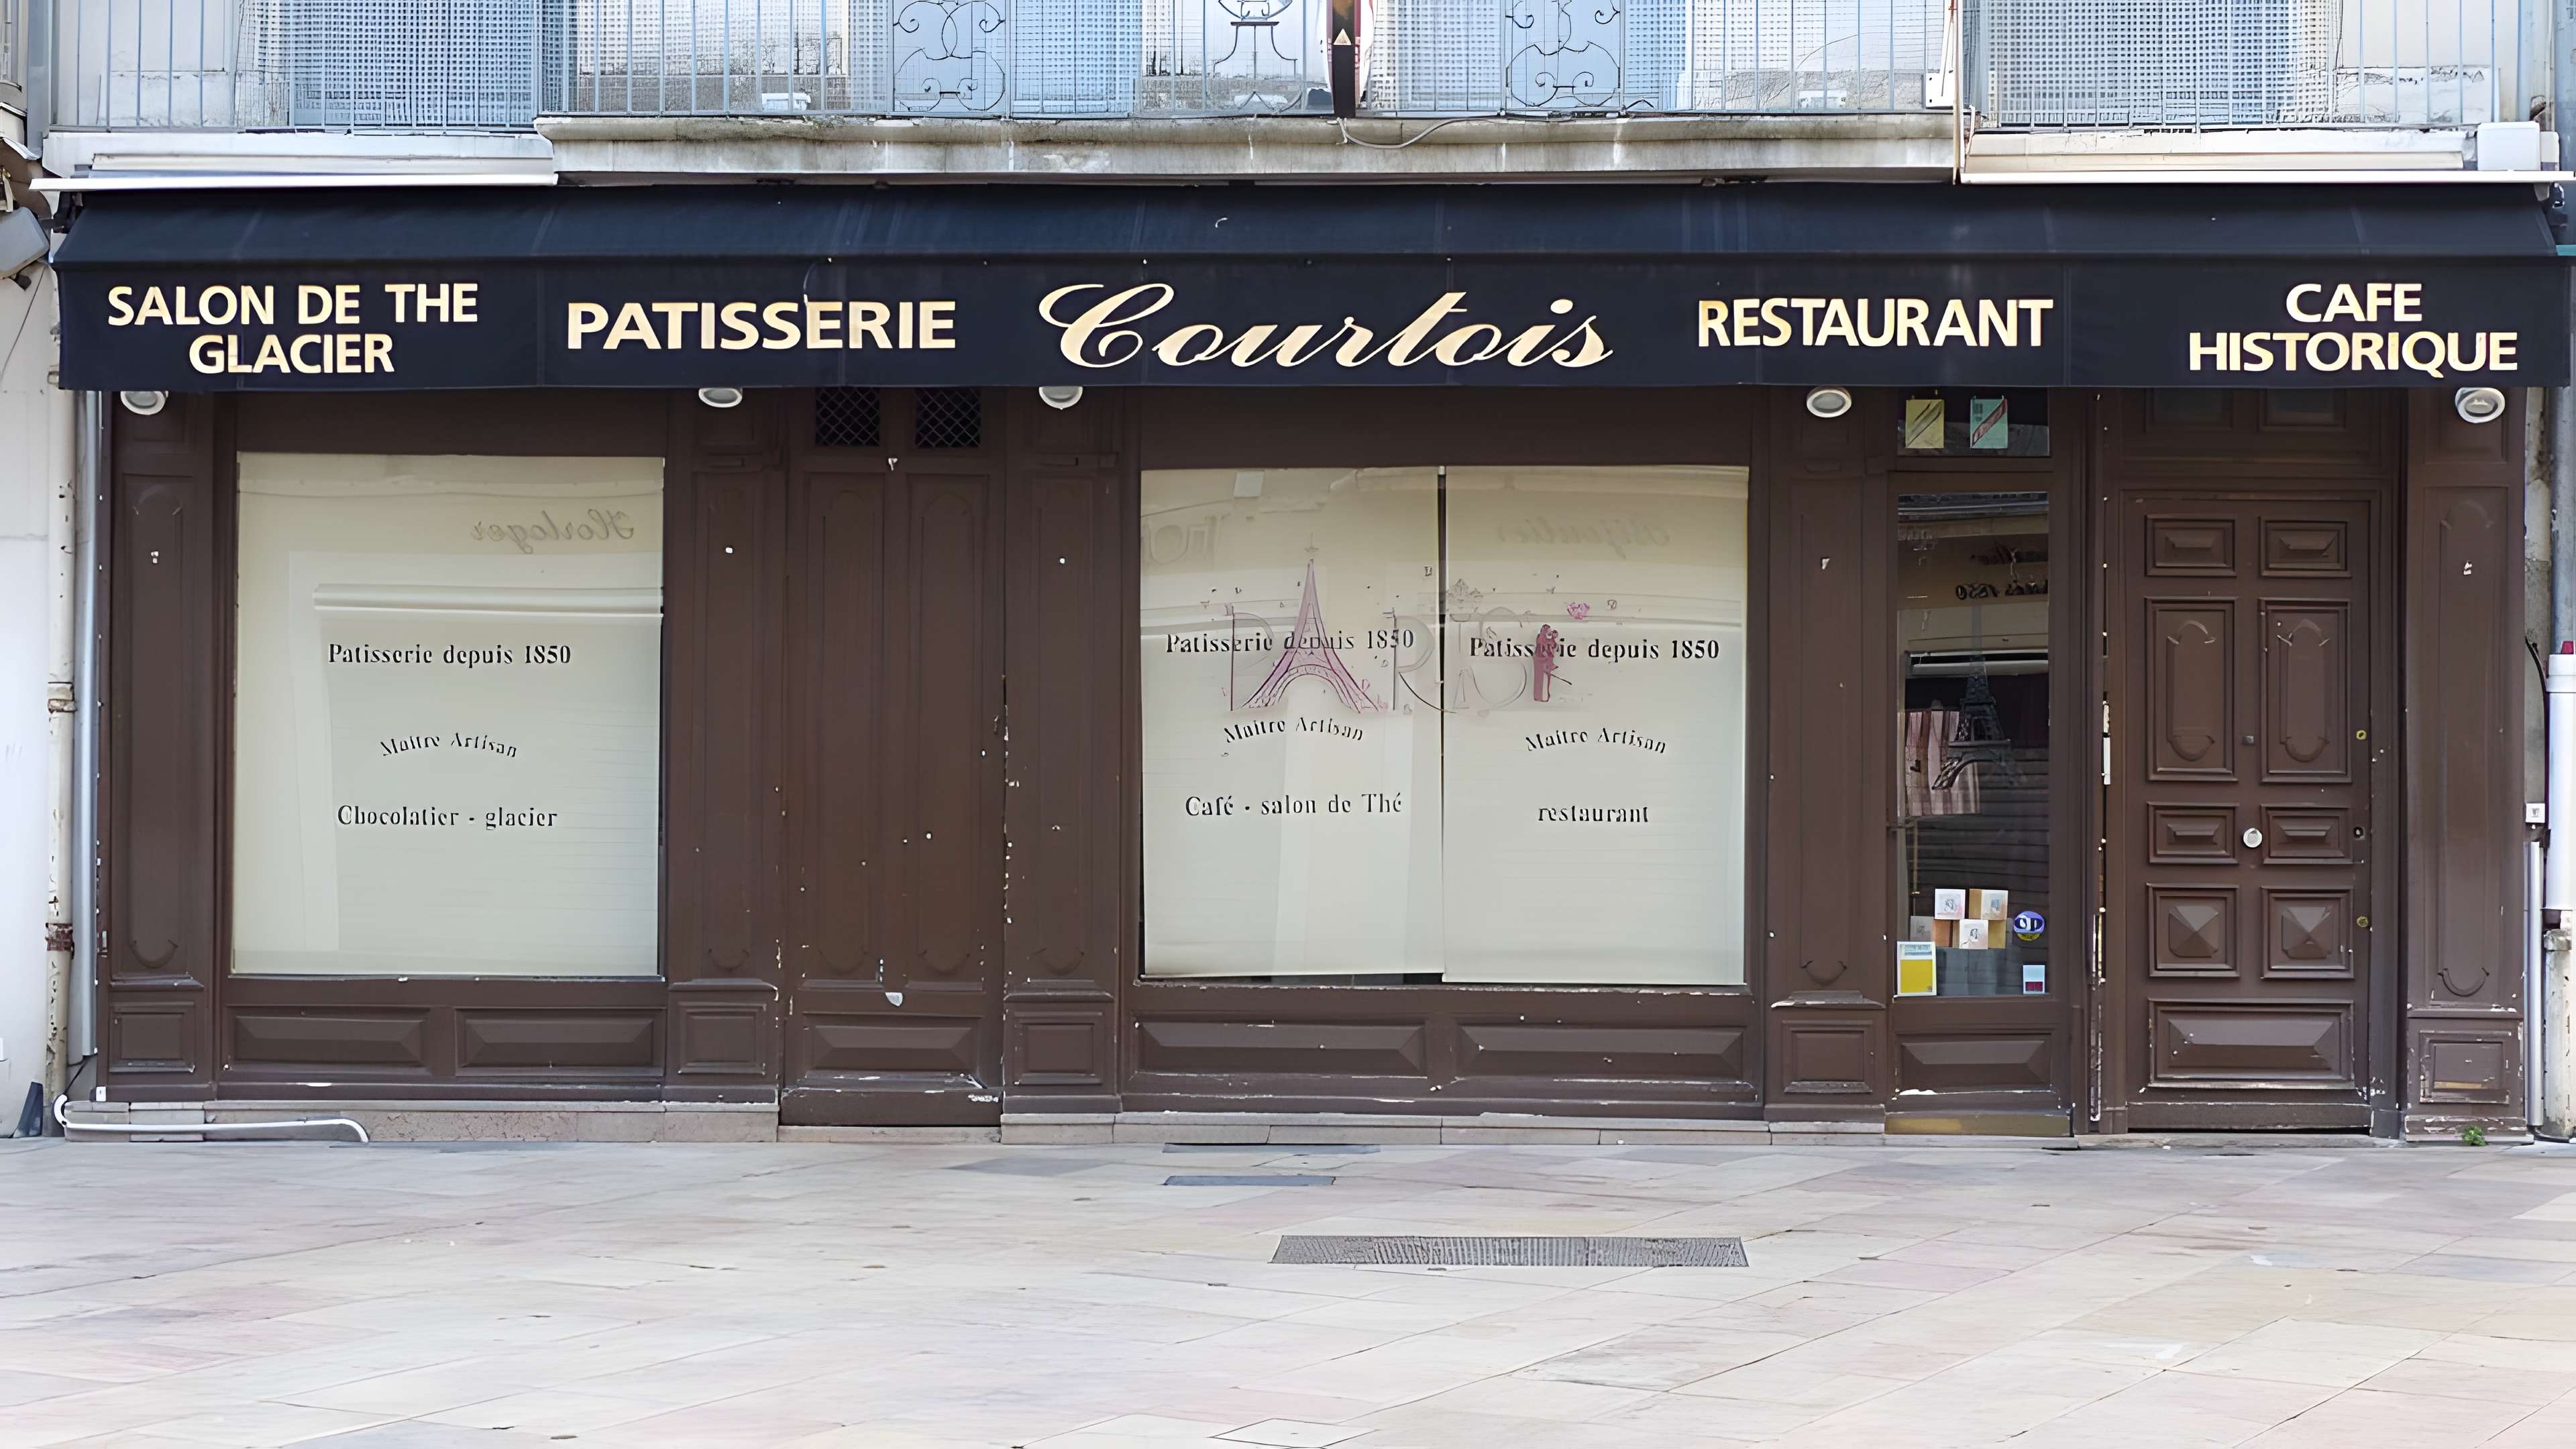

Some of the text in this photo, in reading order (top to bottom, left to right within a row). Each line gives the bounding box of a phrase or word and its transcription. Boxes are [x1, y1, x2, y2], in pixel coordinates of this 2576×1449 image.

[107, 282, 479, 327] SALON DE THE
[2285, 282, 2423, 323] CAFE
[567, 300, 957, 350] PATISSERIE
[1038, 282, 1614, 369] Courtois
[1698, 297, 2054, 347] RESTAURANT
[189, 333, 395, 375] GLACIER
[2188, 331, 2518, 379] HISTORIQUE
[328, 643, 572, 669] Patisserie depuis 1850
[1469, 637, 1720, 664] Patissie depuis 1850
[1295, 716, 1363, 741] Artisan
[1597, 727, 1666, 754] Artisan
[450, 732, 517, 758] Artisan
[337, 804, 460, 826] Chocolatier
[485, 806, 558, 831] glacier
[1185, 794, 1234, 816] Café
[1260, 794, 1317, 816] salon
[1328, 793, 1352, 814] de
[1360, 792, 1402, 814] Thé
[1537, 804, 1649, 823] restaurant
